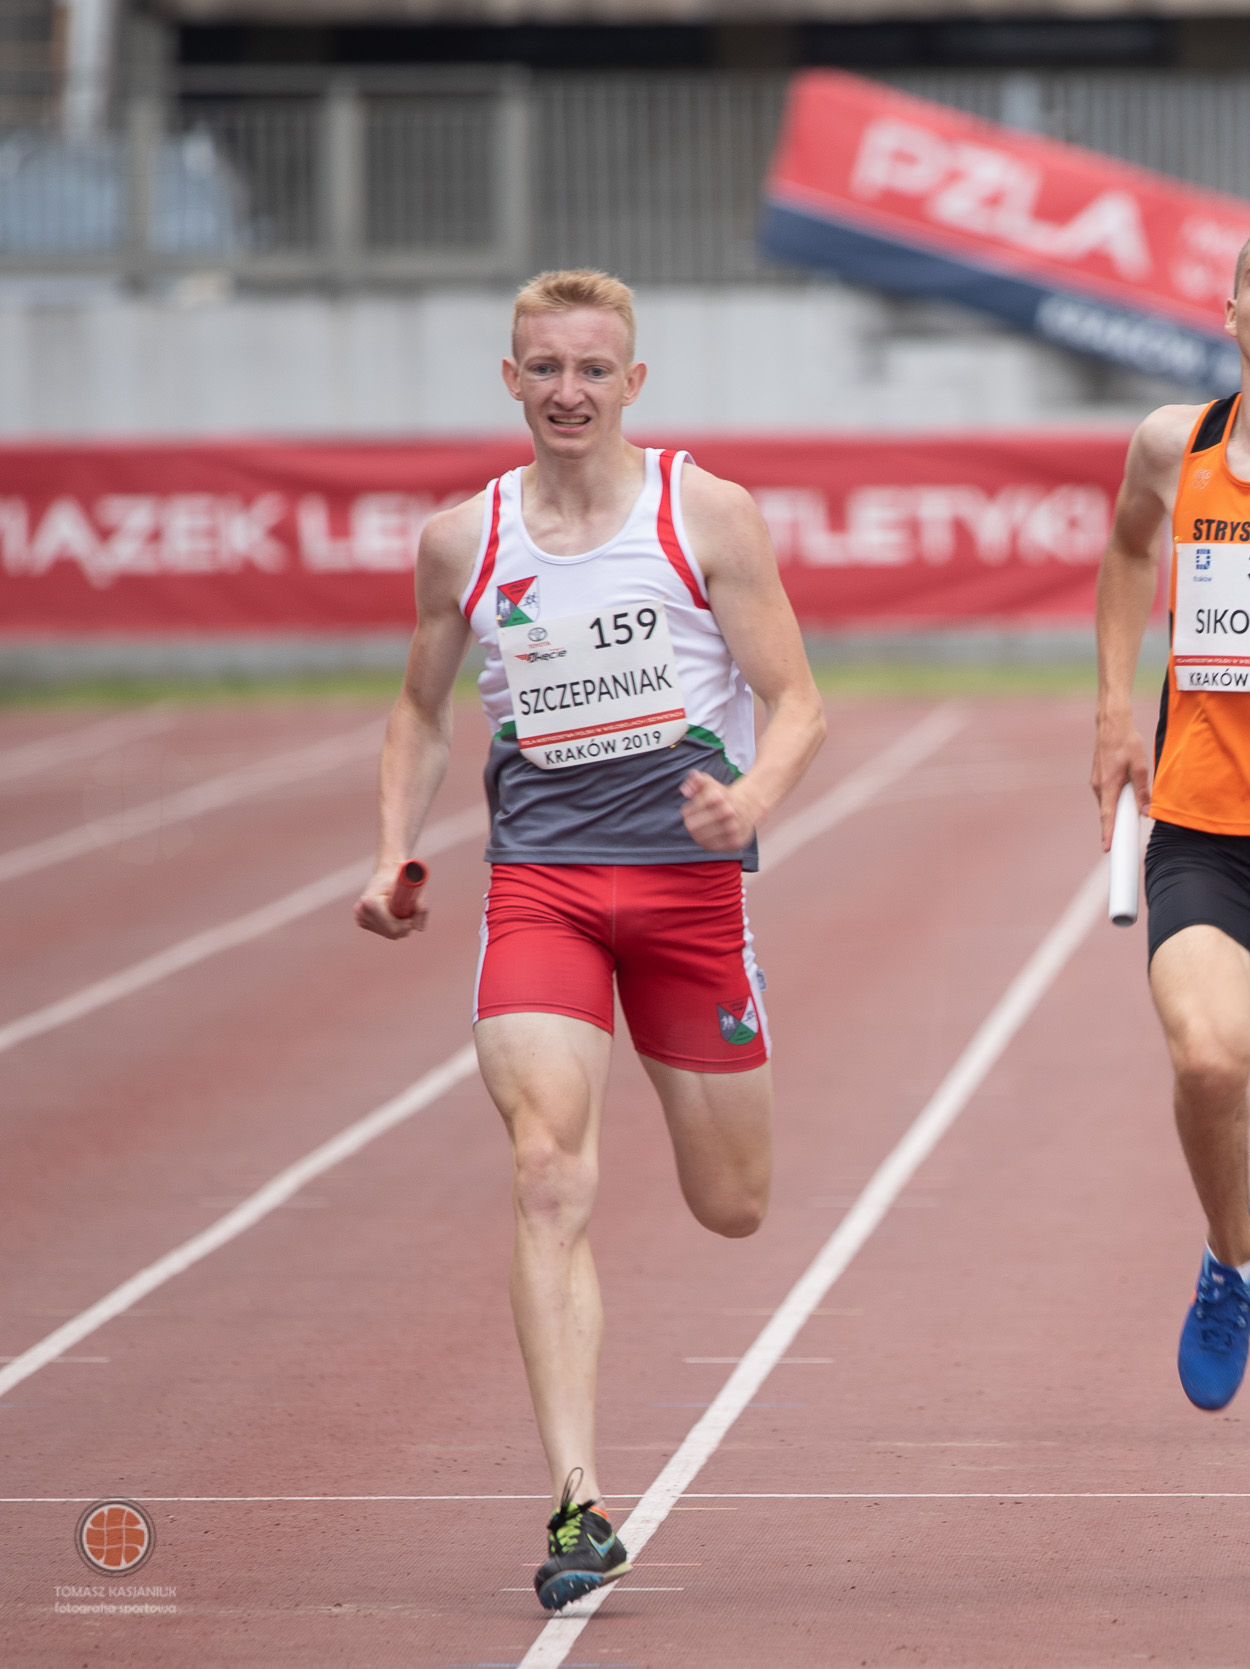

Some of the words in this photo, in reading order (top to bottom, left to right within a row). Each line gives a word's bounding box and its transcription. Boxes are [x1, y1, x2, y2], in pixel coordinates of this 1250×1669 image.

[851, 117, 1152, 281] PZLA
[0, 491, 289, 590] IĄZEK
[752, 484, 1112, 568] TLETYKI
[589, 608, 657, 649] 159
[519, 664, 673, 716] SZCZEPANIAK
[1189, 668, 1249, 687] KRAKÓW
[545, 739, 616, 765] KRAKÓW
[622, 731, 661, 751] 2019
